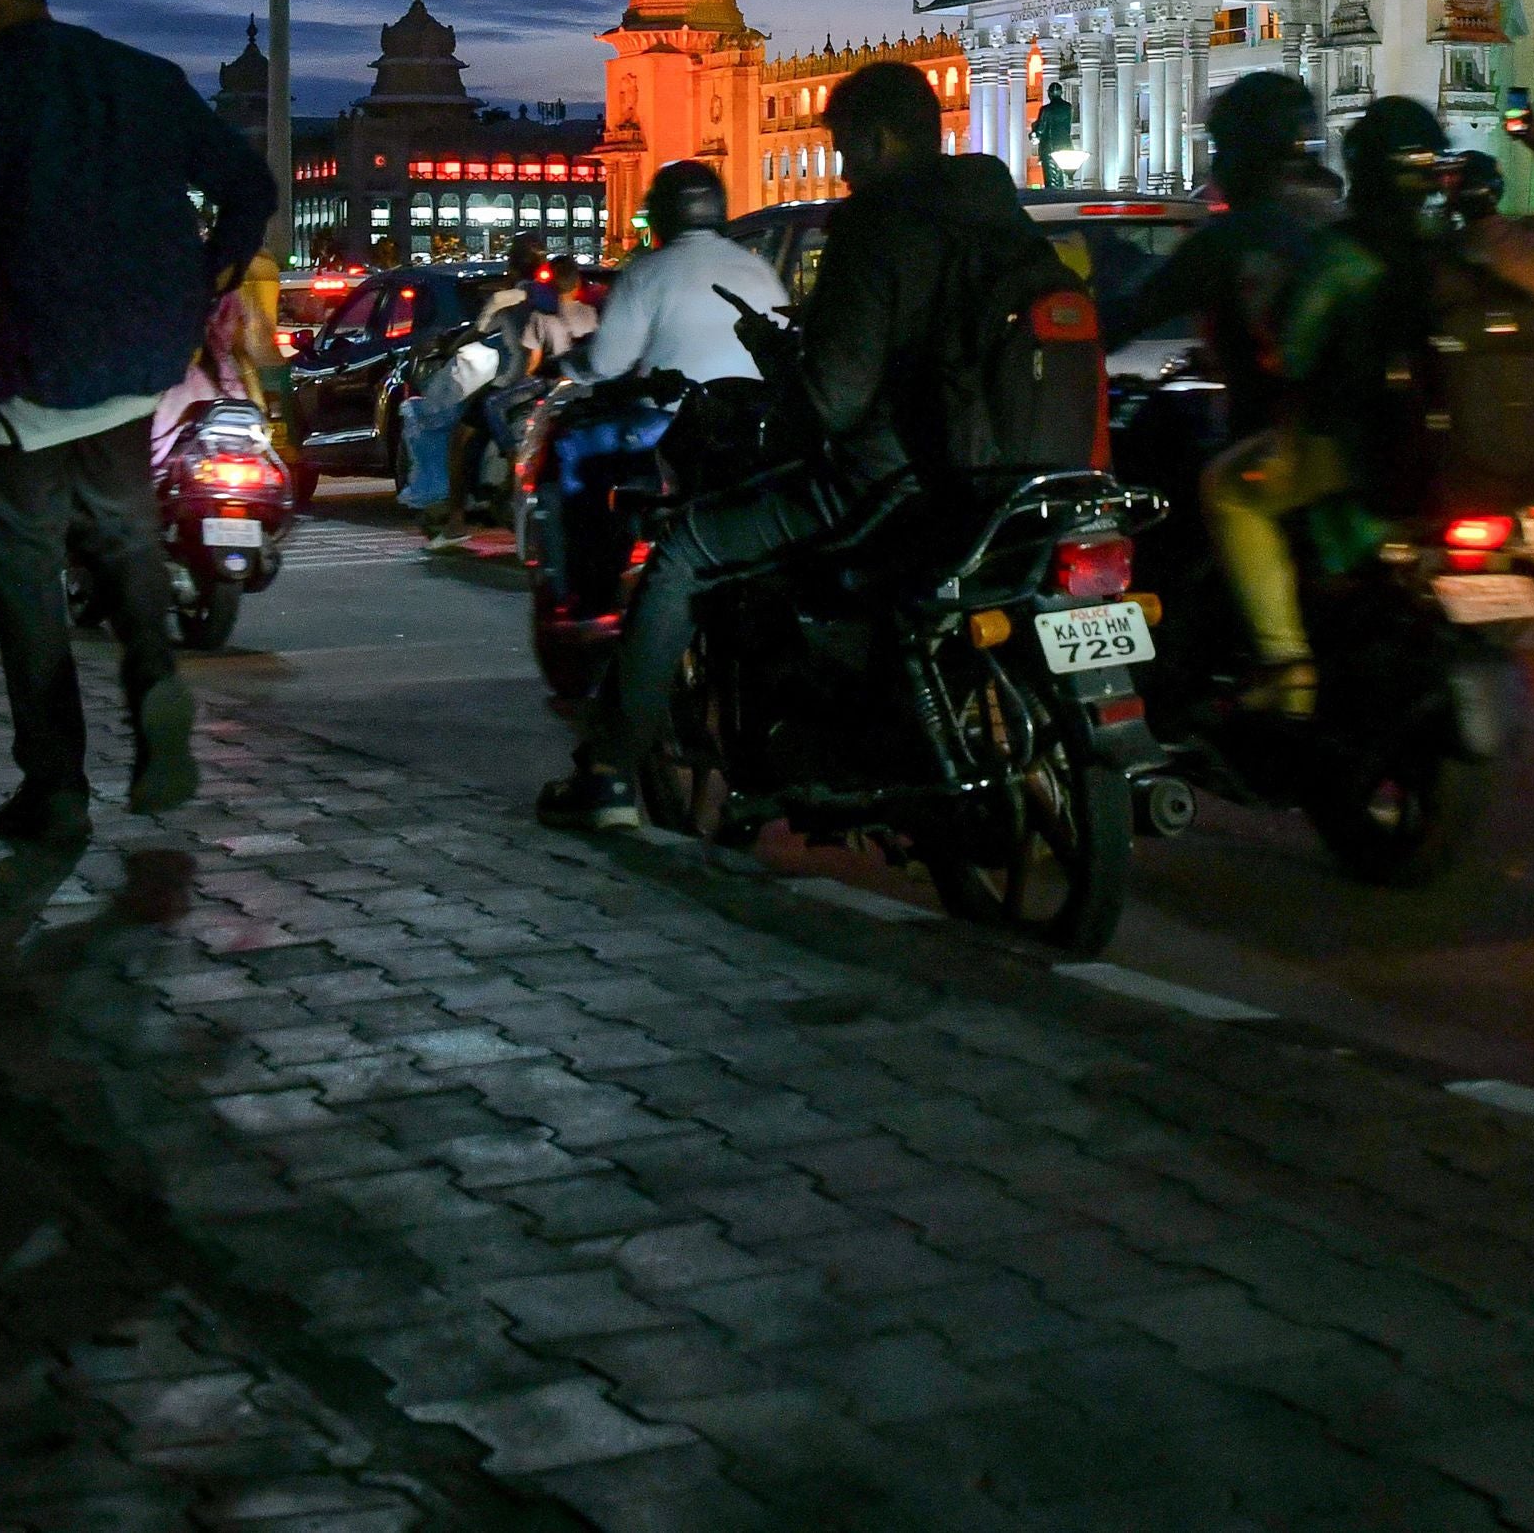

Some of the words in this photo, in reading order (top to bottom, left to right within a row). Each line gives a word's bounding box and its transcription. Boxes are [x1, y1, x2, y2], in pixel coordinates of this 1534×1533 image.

[1070, 606, 1109, 621] POLICE
[1054, 624, 1079, 640] KA
[1082, 621, 1102, 637] 02
[1105, 617, 1131, 634] HM
[1059, 636, 1136, 663] 729
